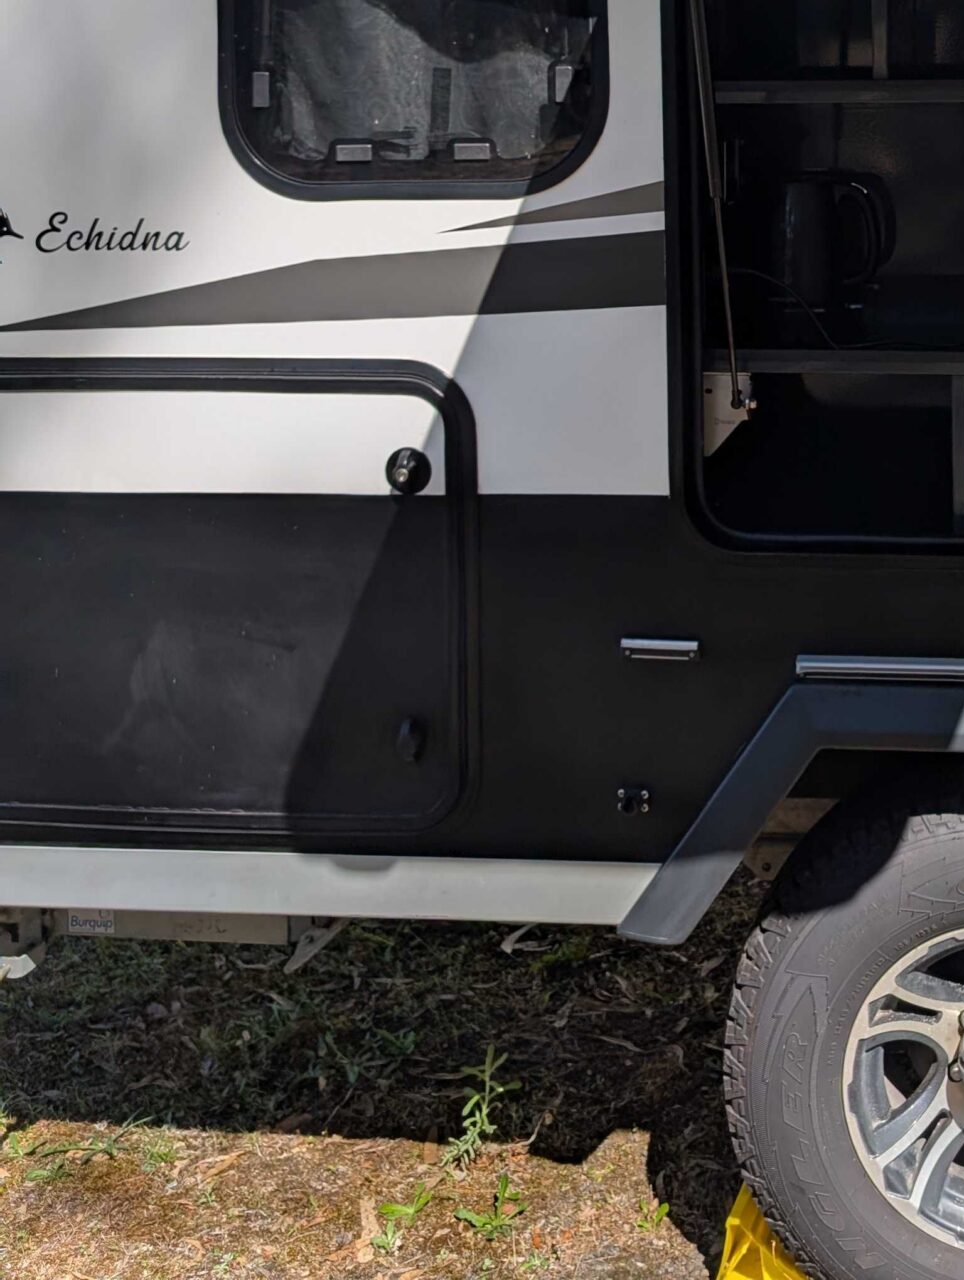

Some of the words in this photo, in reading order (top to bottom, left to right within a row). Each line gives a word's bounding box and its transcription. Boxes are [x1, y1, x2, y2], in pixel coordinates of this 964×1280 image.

[36, 212, 190, 253] Echidna
[70, 915, 113, 931] Burquip
[781, 1031, 898, 1279] NGLER
